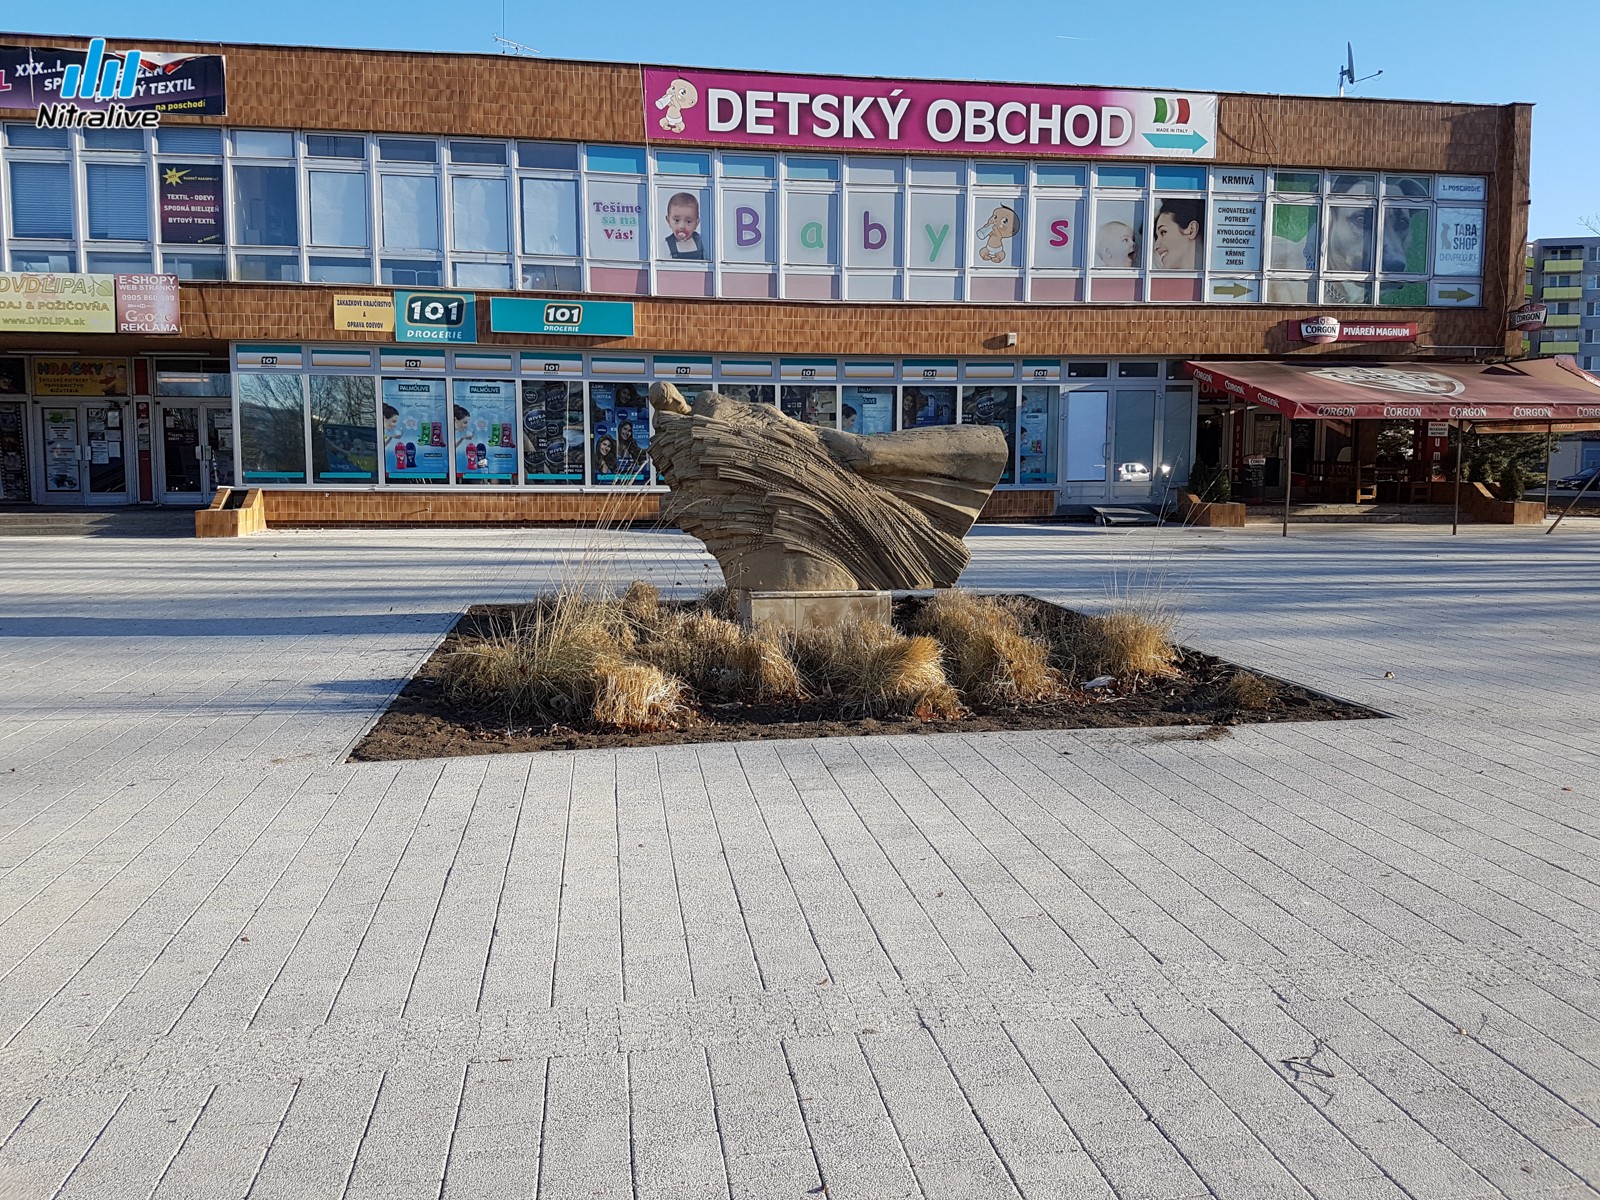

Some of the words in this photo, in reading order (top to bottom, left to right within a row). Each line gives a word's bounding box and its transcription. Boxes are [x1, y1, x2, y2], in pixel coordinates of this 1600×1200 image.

[149, 78, 195, 96] TEXTIL
[168, 99, 206, 111] poschodí
[708, 88, 911, 140] DETSKÝ
[926, 99, 1133, 147] OBCHOD
[1222, 175, 1255, 185] KRMIVÁ
[592, 201, 642, 214] Tešíme
[602, 215, 617, 225] sa
[619, 216, 637, 226] na
[603, 228, 634, 241] Vás!
[1216, 228, 1256, 236] KYNOLOGICKÉ
[1454, 224, 1477, 236] TARA
[1222, 237, 1250, 245] POMÔCKY
[1453, 237, 1477, 250] SHOP
[119, 276, 176, 285] E-SHOPY
[25, 301, 34, 309] &
[38, 299, 110, 311] POŽIČOVŇA
[125, 310, 174, 323] Gooe
[411, 301, 459, 321] 101
[547, 306, 580, 322] 101
[2, 316, 85, 326] www.DVDLIPA.sk
[121, 323, 178, 332] REKLAMA
[1343, 325, 1374, 336] PIVÁREŇ
[1376, 327, 1409, 336] MAGNUM
[406, 329, 463, 339] DROGERIE
[923, 369, 937, 377] 101
[1034, 369, 1048, 377] 101
[399, 384, 430, 392] PALMOLIVE
